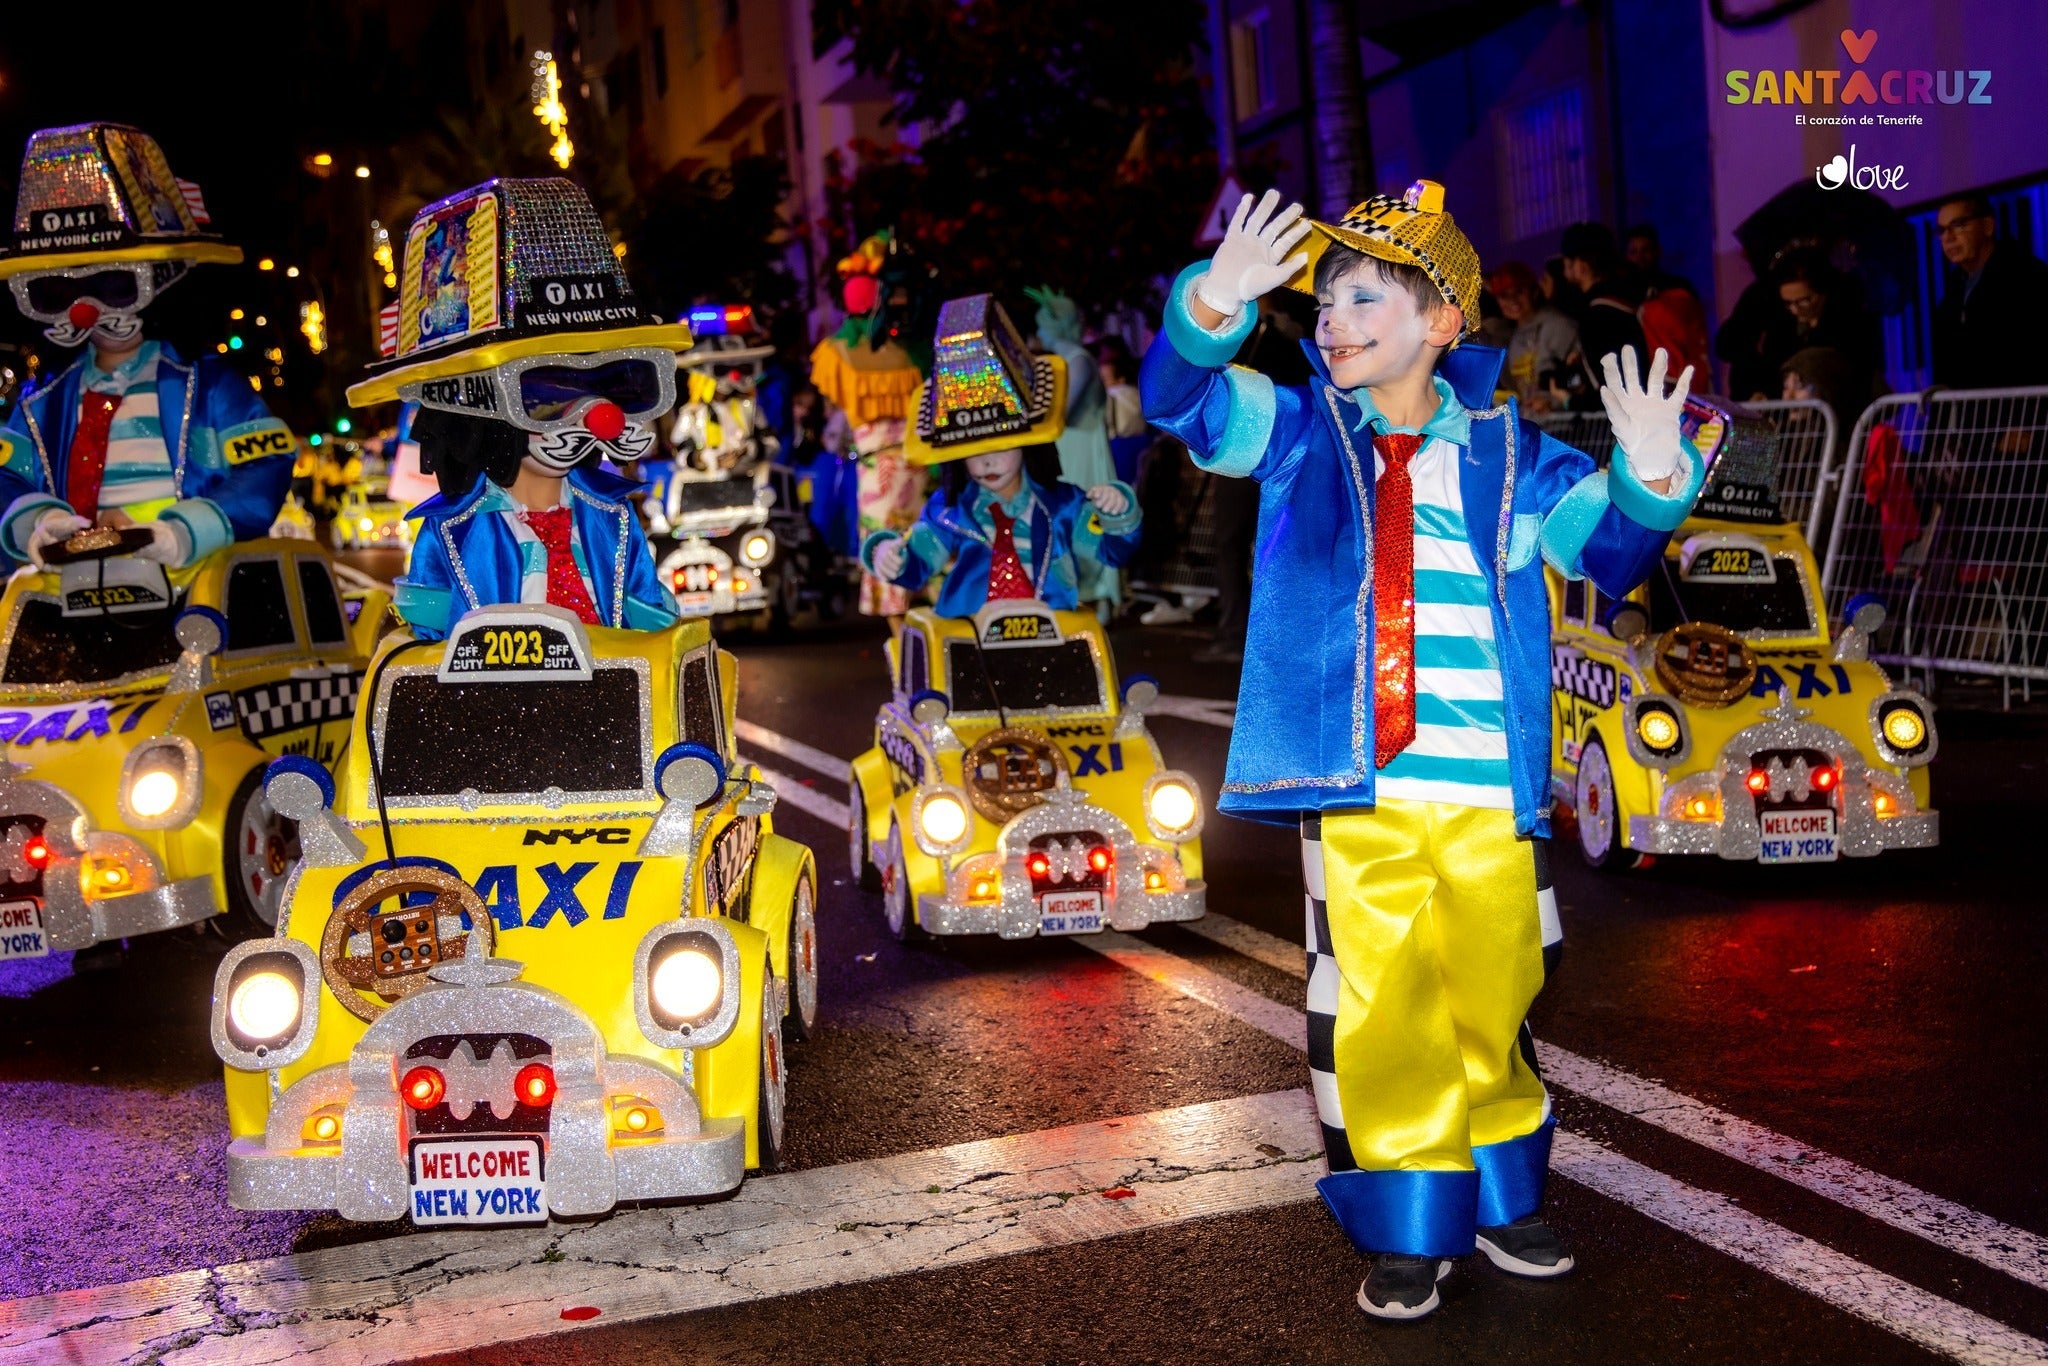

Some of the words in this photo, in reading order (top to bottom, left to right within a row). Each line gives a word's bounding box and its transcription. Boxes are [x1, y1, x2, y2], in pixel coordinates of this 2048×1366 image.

[1356, 198, 1392, 219] XI
[42, 211, 95, 232] TAXI
[21, 239, 52, 250] NEW
[54, 234, 90, 247] YORK
[91, 230, 122, 243] CITY
[545, 282, 604, 305] TAXI
[526, 311, 560, 325] NEW
[562, 309, 604, 323] YORK
[604, 306, 637, 319] CITY
[955, 407, 998, 427] TAXI
[940, 429, 966, 442] NEW
[233, 433, 289, 459] NYC
[1722, 485, 1760, 502] TAXI
[1704, 501, 1726, 513] NEW
[1752, 507, 1774, 518] CITY
[1712, 550, 1750, 572] 2023
[1003, 617, 1039, 639] 2023
[457, 646, 479, 657] OFF
[484, 631, 544, 664] 2023
[547, 645, 569, 656] OFF
[453, 659, 484, 670] DUTY
[543, 658, 575, 668] DUTY
[1750, 663, 1852, 698] AXI
[1069, 743, 1124, 776] XI
[1765, 816, 1828, 834] WELCOME
[522, 828, 631, 845] NYC
[1762, 840, 1792, 858] NEW
[1797, 838, 1834, 856] YORK
[1048, 898, 1095, 912] WELCOME
[1042, 917, 1066, 931] NEW
[1071, 915, 1102, 929] YORK
[1, 933, 43, 954] YORK
[421, 1150, 531, 1179] WELCOME
[415, 1189, 468, 1217] NEW
[476, 1187, 541, 1215] YORK
